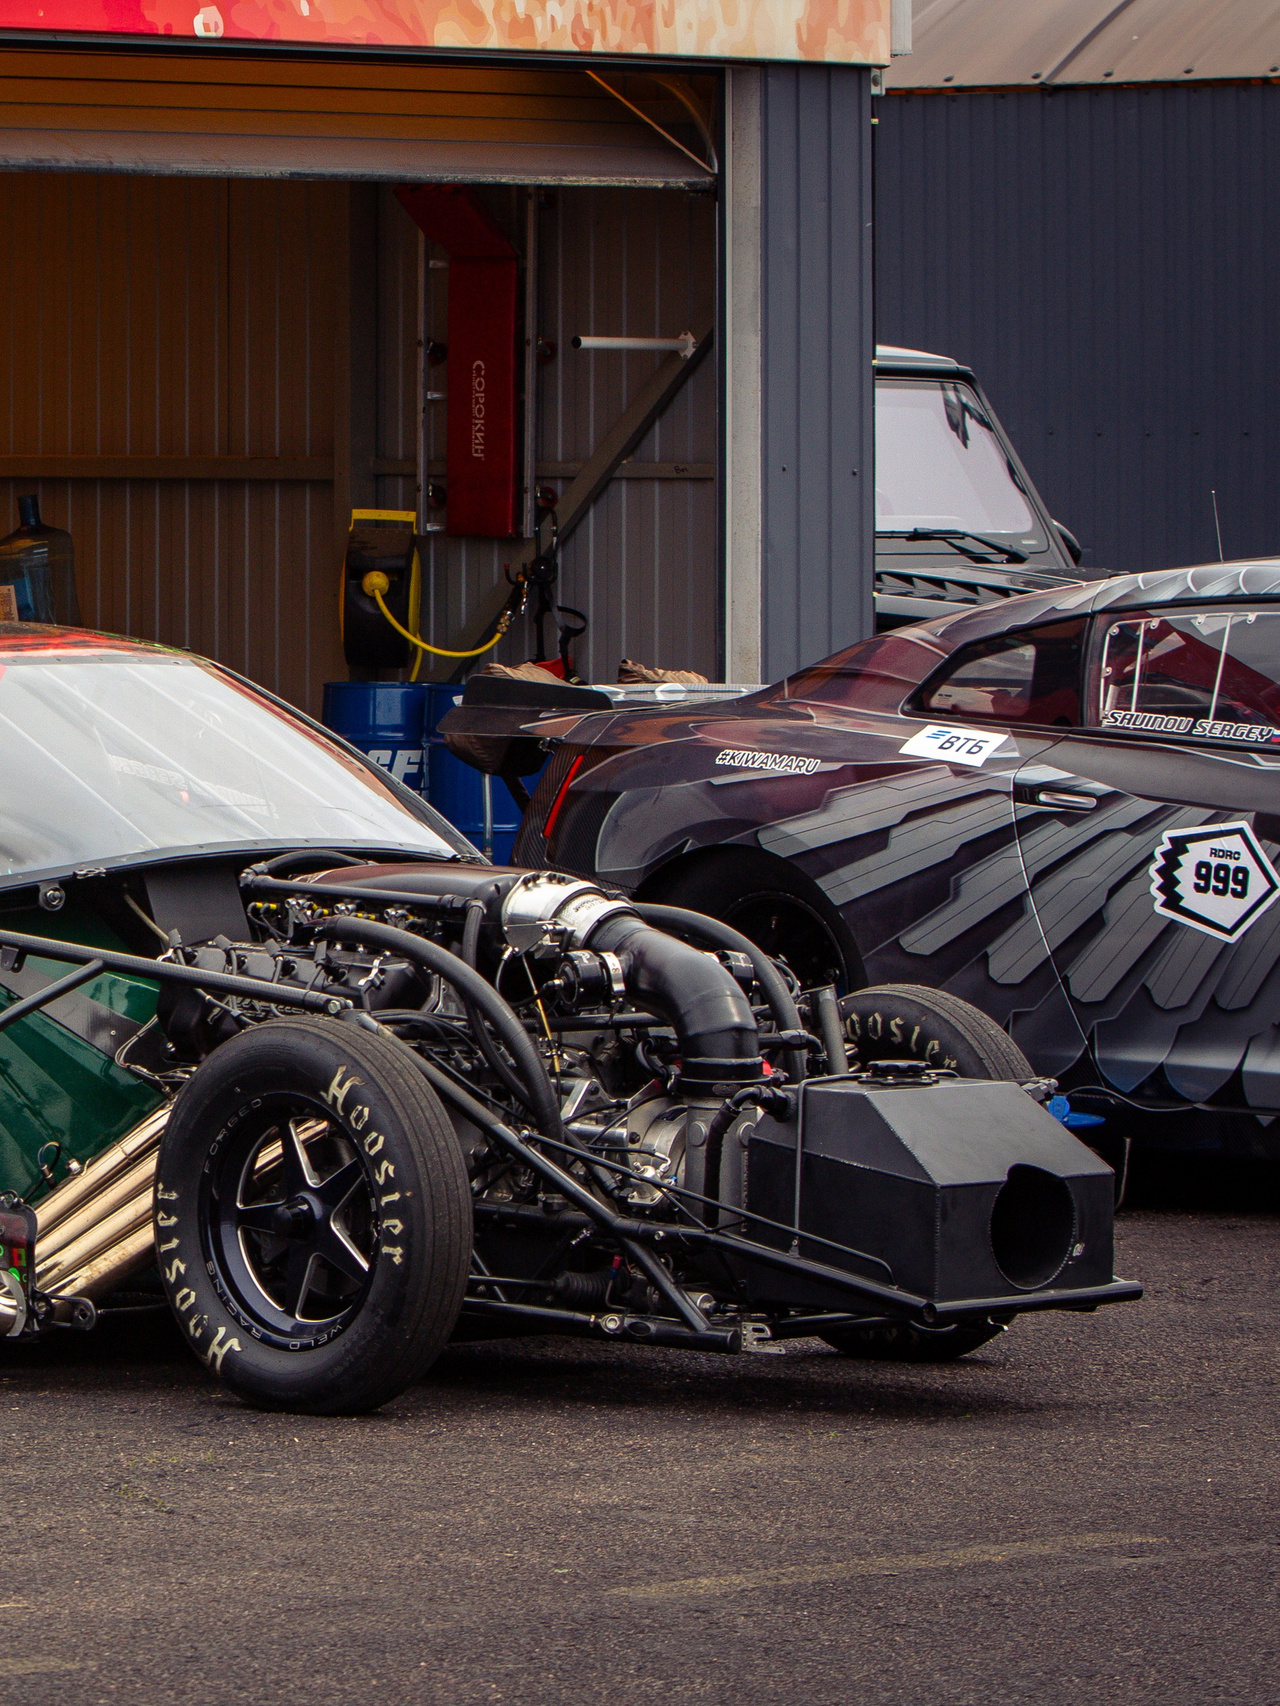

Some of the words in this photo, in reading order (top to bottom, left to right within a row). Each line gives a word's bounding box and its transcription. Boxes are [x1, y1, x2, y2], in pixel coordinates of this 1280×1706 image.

[473, 360, 485, 458] СОРОКИН
[937, 735, 990, 755] ВТБ
[1192, 719, 1274, 742] SERGEY
[716, 749, 821, 776] #KIWAMARU
[1209, 847, 1241, 861] RDRC
[1193, 860, 1250, 899] 999
[204, 1098, 262, 1174] FORGED
[320, 1064, 412, 1266] Hoosier
[156, 1182, 242, 1375] Hoosier
[205, 1259, 262, 1339] RACING
[289, 1324, 342, 1350] WELD
